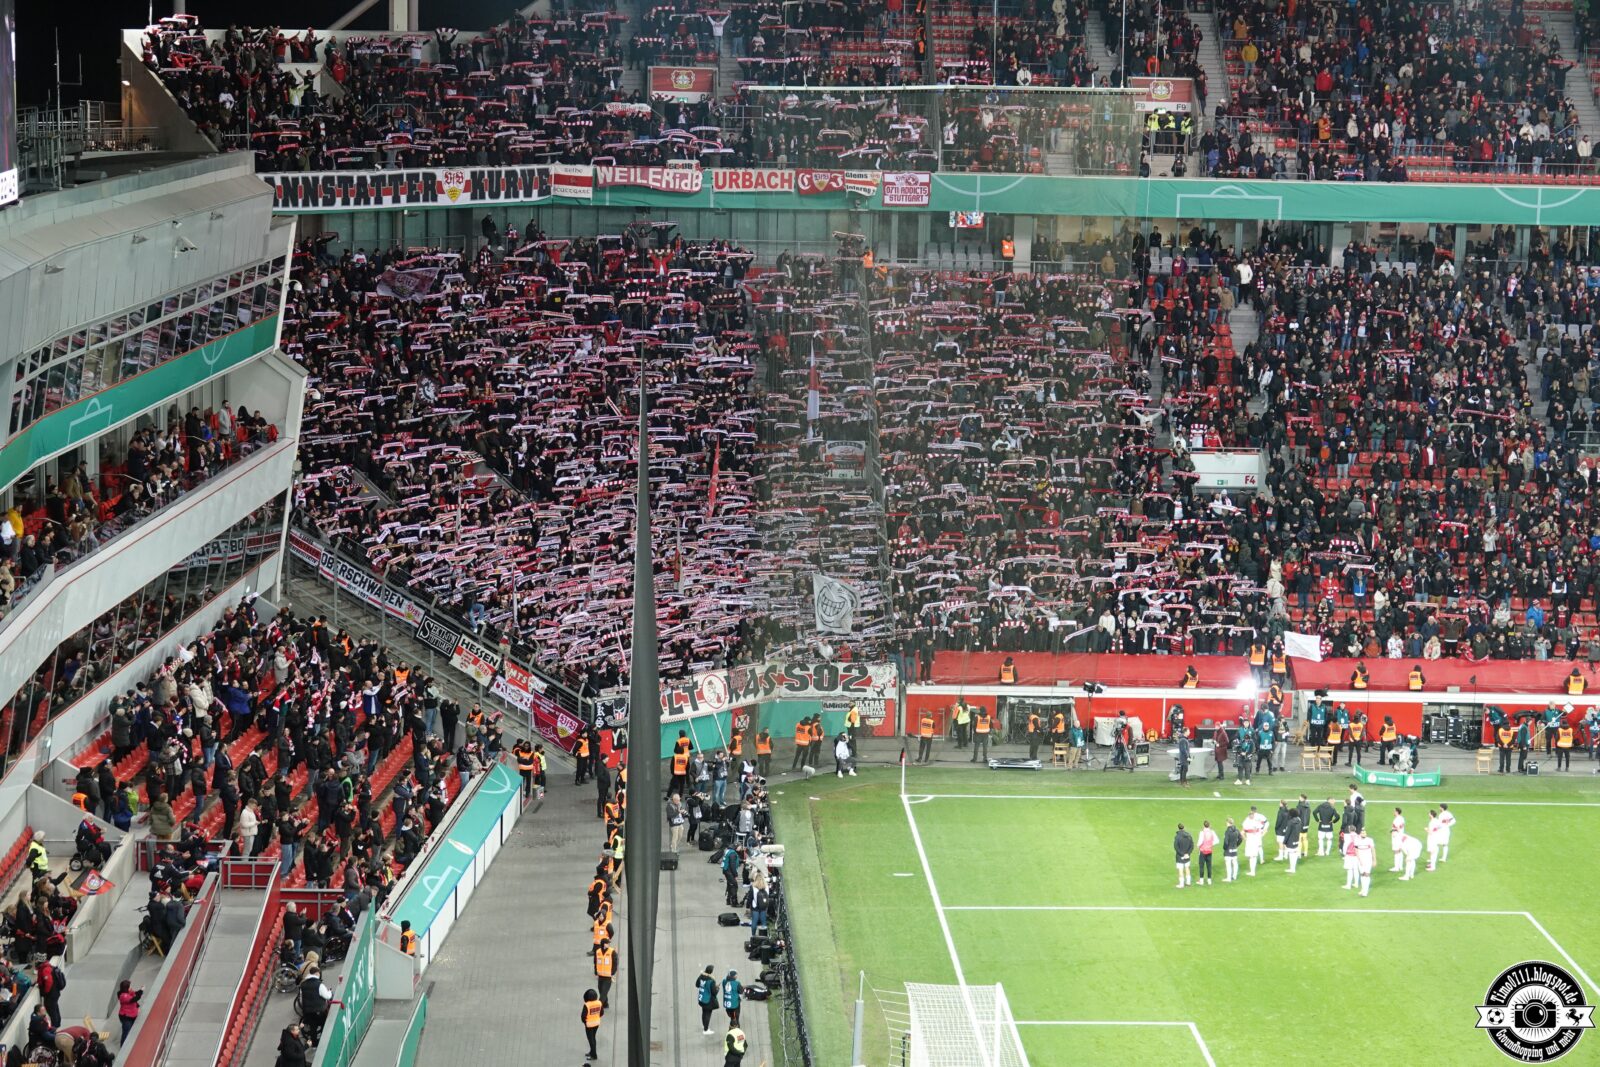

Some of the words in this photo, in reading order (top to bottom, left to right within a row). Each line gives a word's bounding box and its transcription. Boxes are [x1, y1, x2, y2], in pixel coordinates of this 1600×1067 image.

[470, 167, 549, 201] KURVE
[714, 171, 794, 190] URBACH
[886, 186, 899, 194] 0711
[900, 186, 928, 195] ADDICTS
[889, 194, 924, 203] STUTTGART
[1244, 475, 1256, 485] F4
[460, 638, 500, 668] HESSEN
